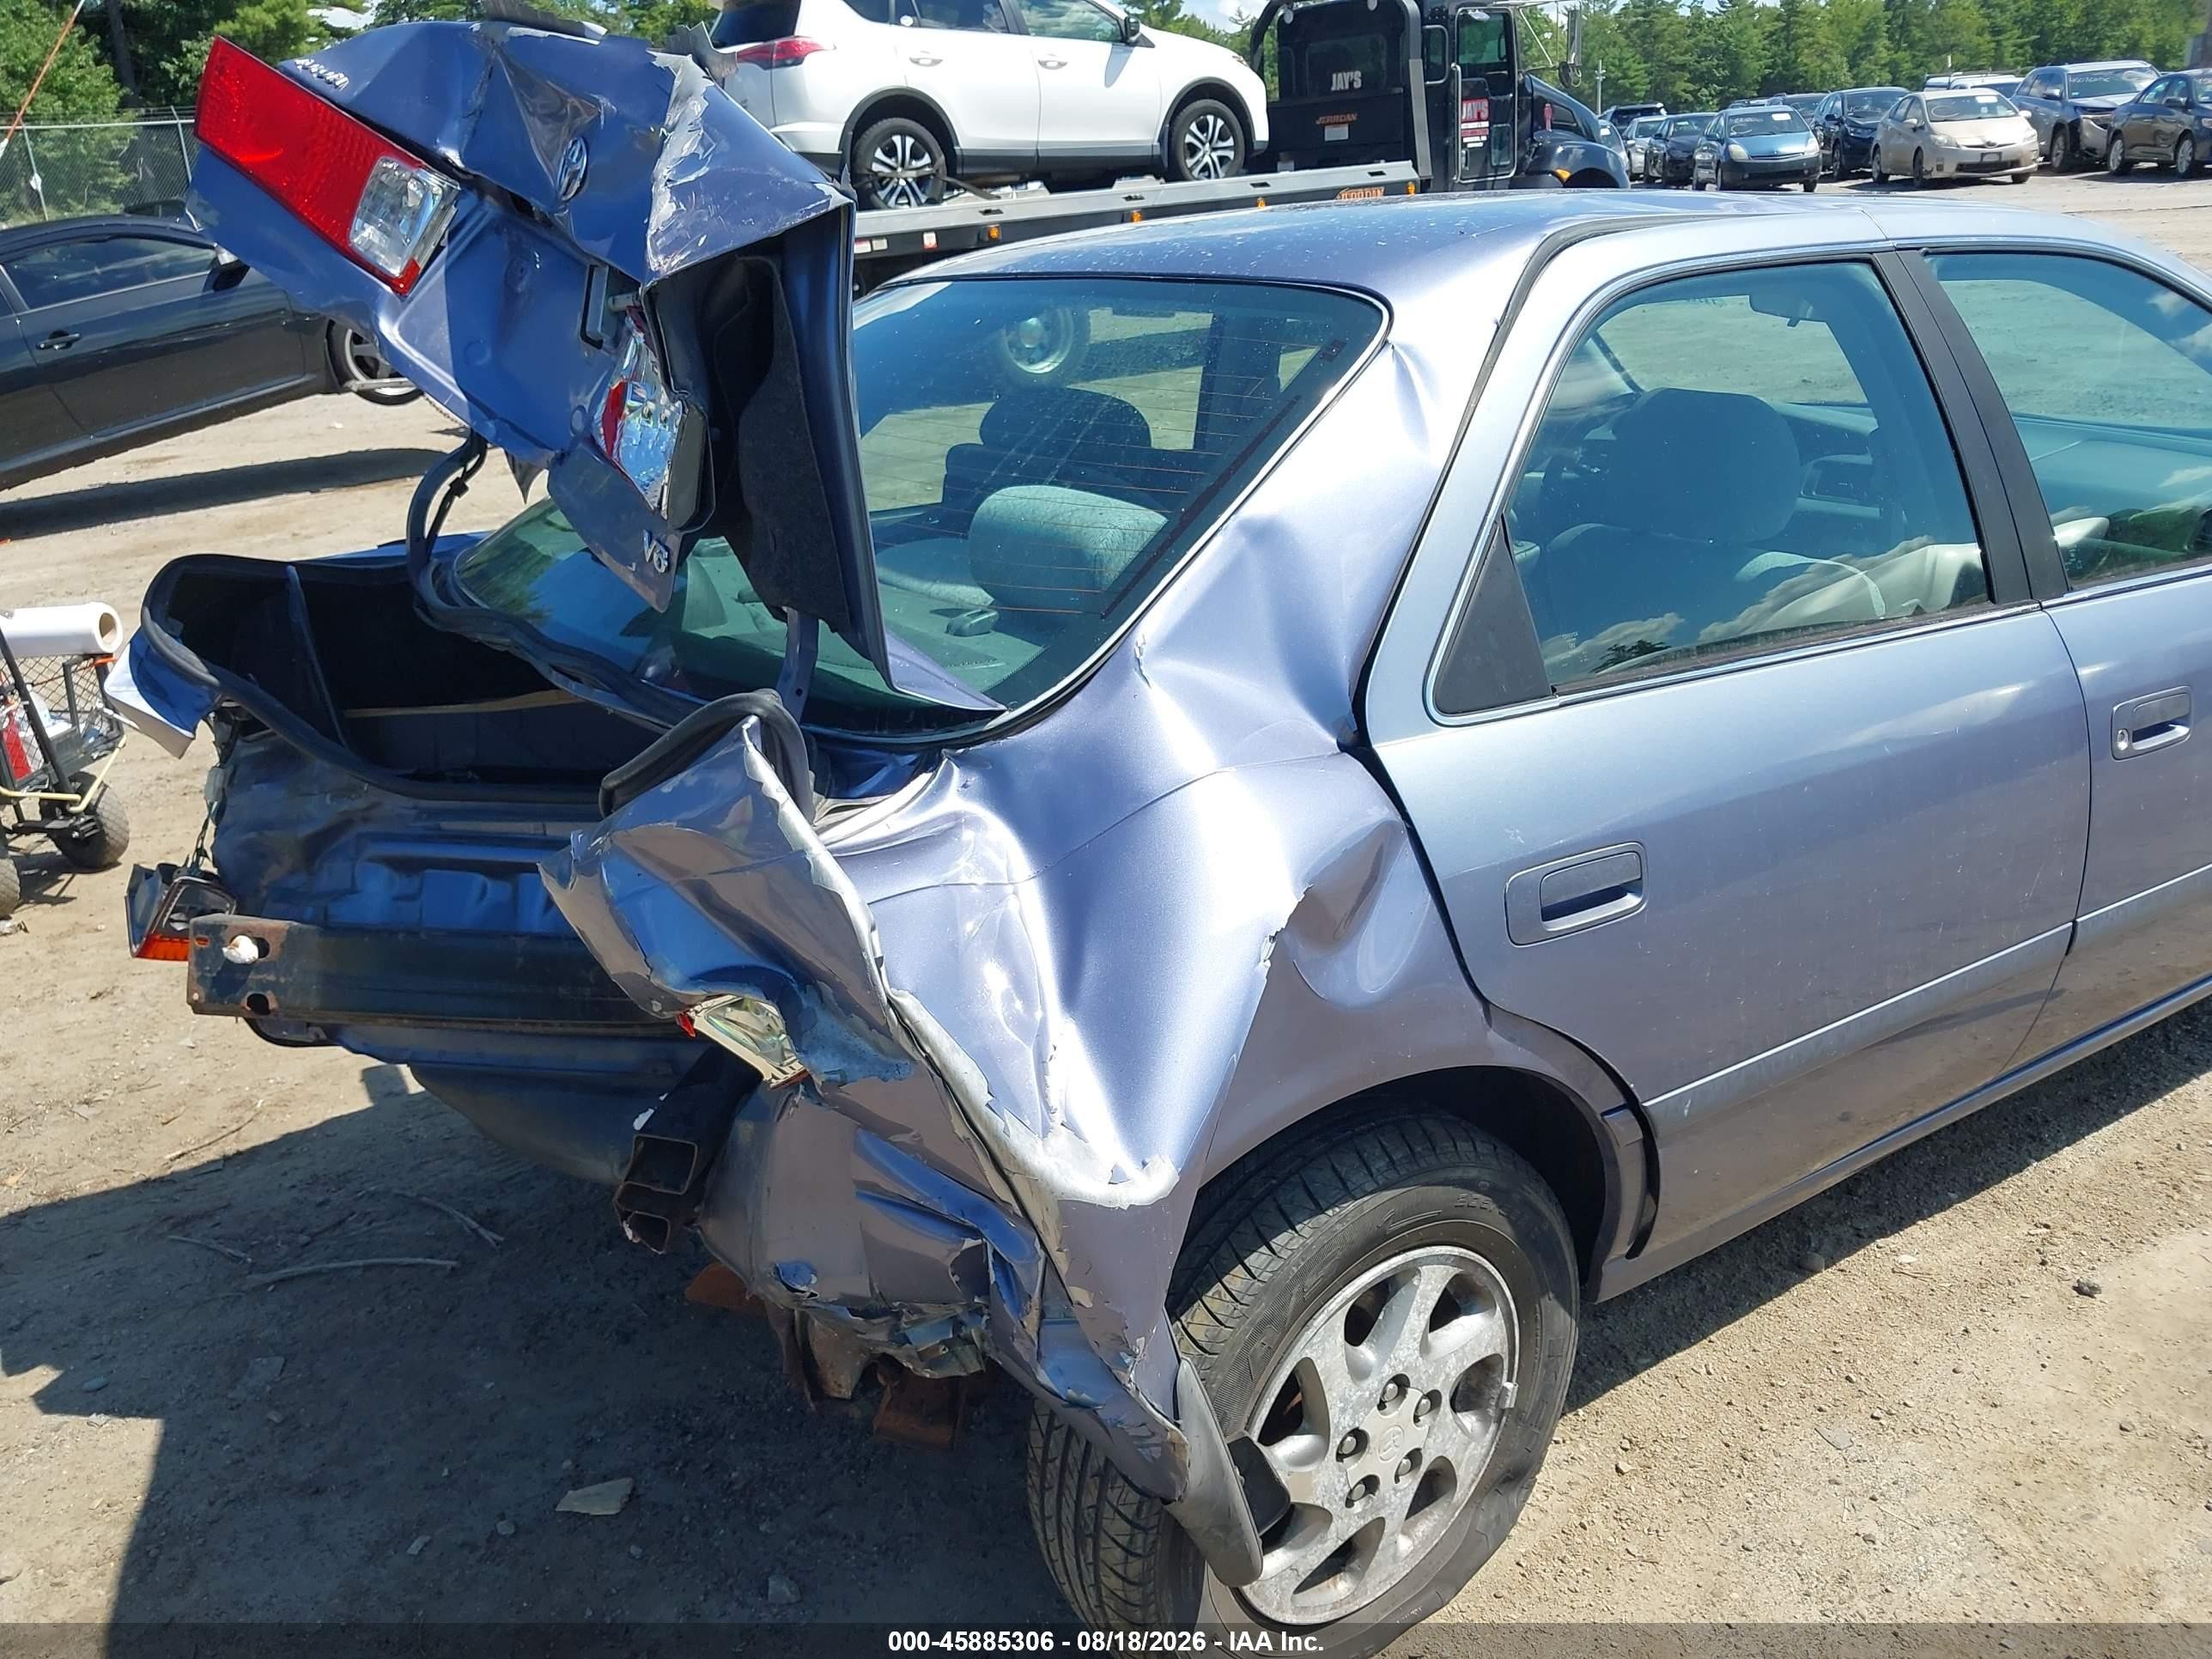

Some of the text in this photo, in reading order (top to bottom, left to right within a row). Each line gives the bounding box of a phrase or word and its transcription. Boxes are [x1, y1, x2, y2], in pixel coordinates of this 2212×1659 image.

[1331, 70, 1362, 91] JAY'S
[1462, 99, 1489, 120] JAY'S
[642, 530, 669, 574] V6
